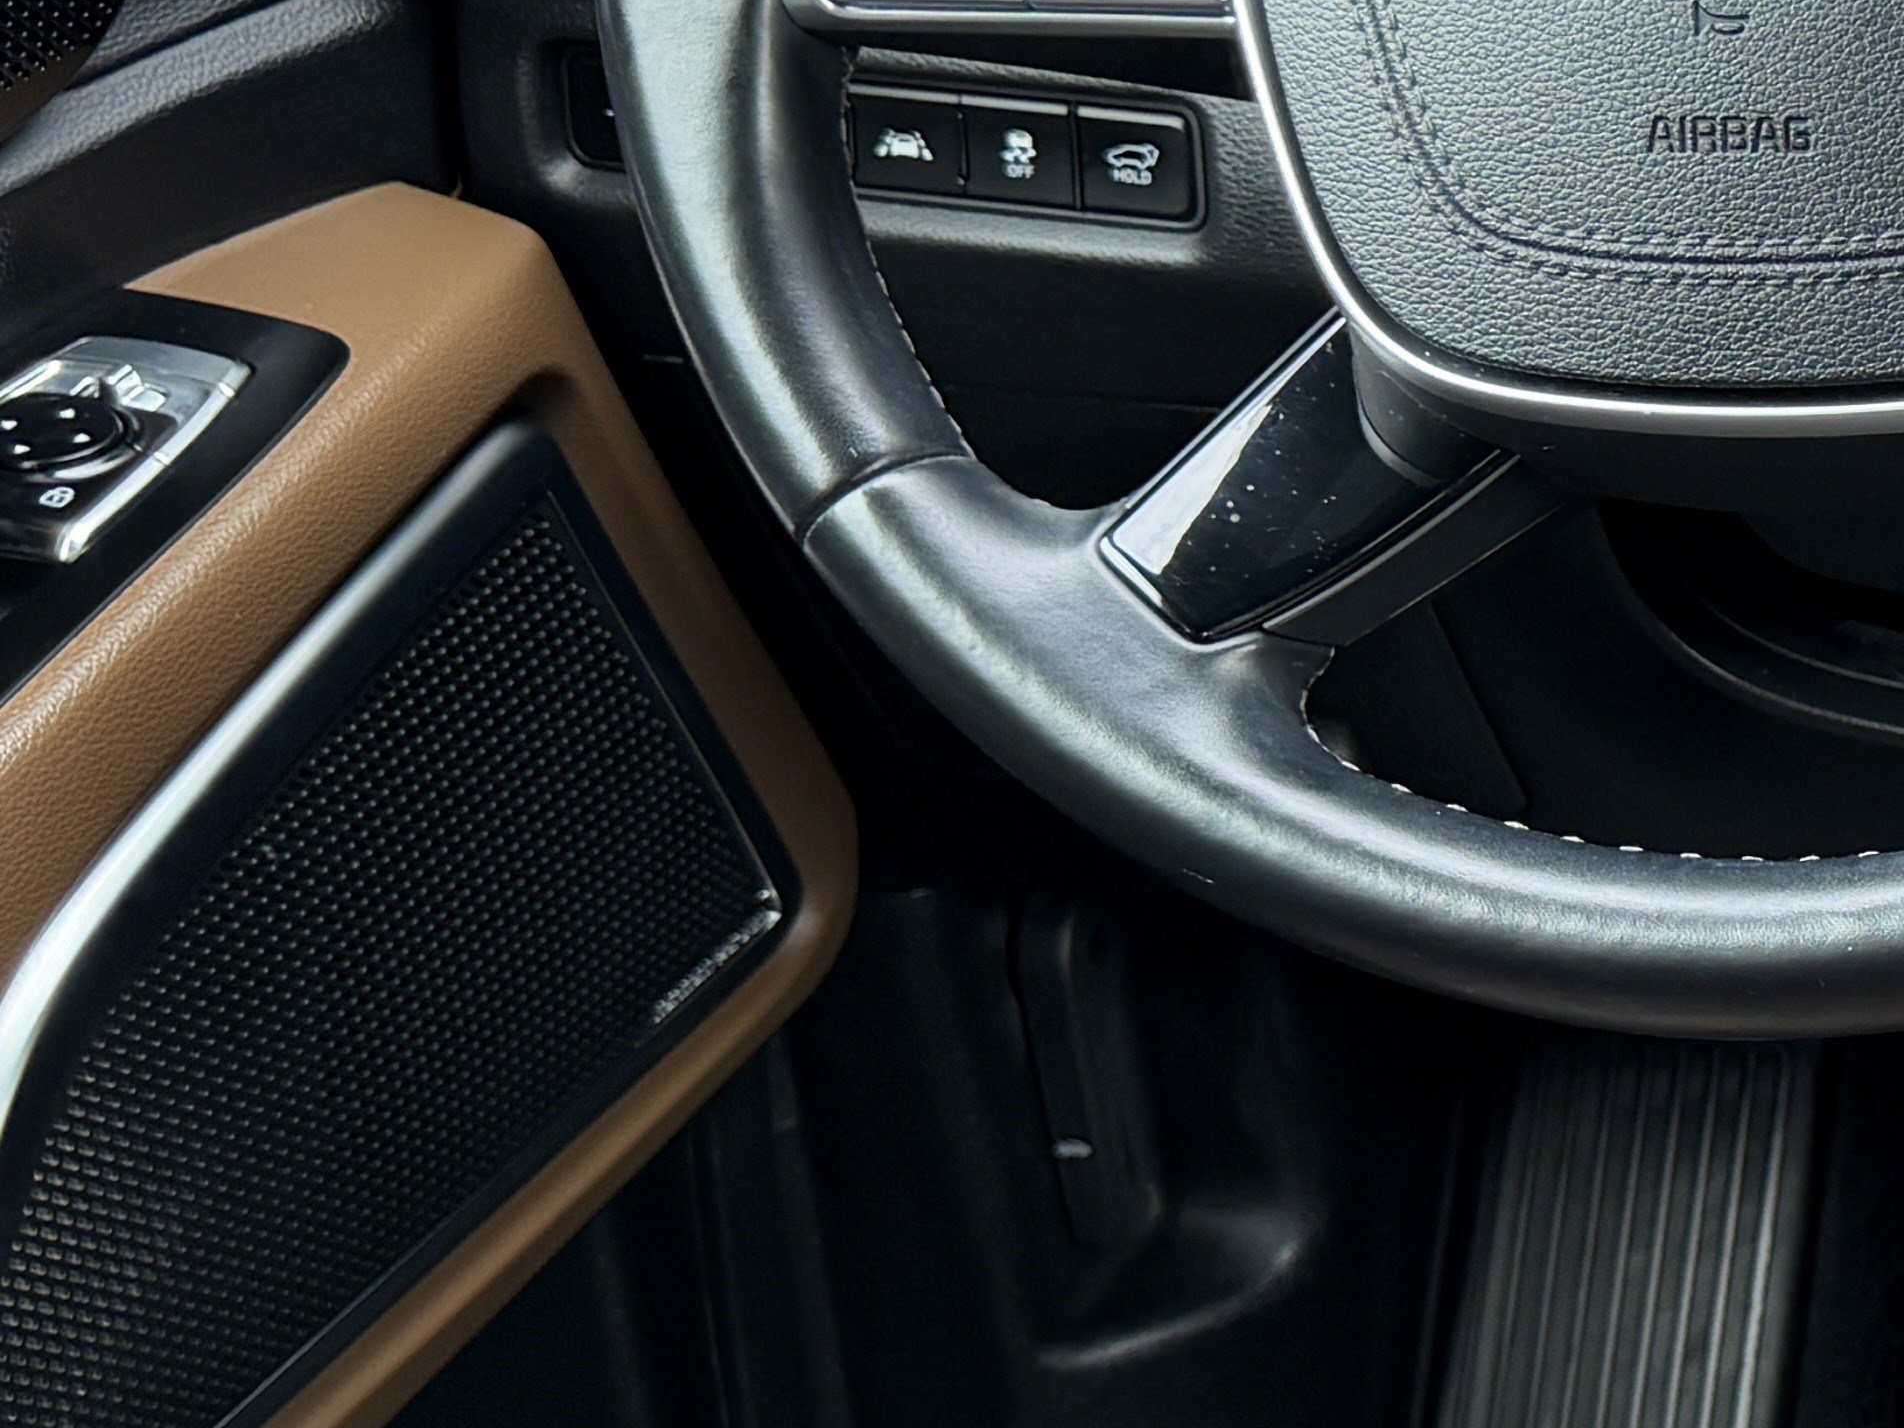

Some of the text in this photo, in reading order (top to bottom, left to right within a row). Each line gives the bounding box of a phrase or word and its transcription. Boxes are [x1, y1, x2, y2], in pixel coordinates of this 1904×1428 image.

[1648, 114, 1812, 154] AIRBAG
[1005, 161, 1036, 179] OFF
[1111, 166, 1153, 186] HOLD
